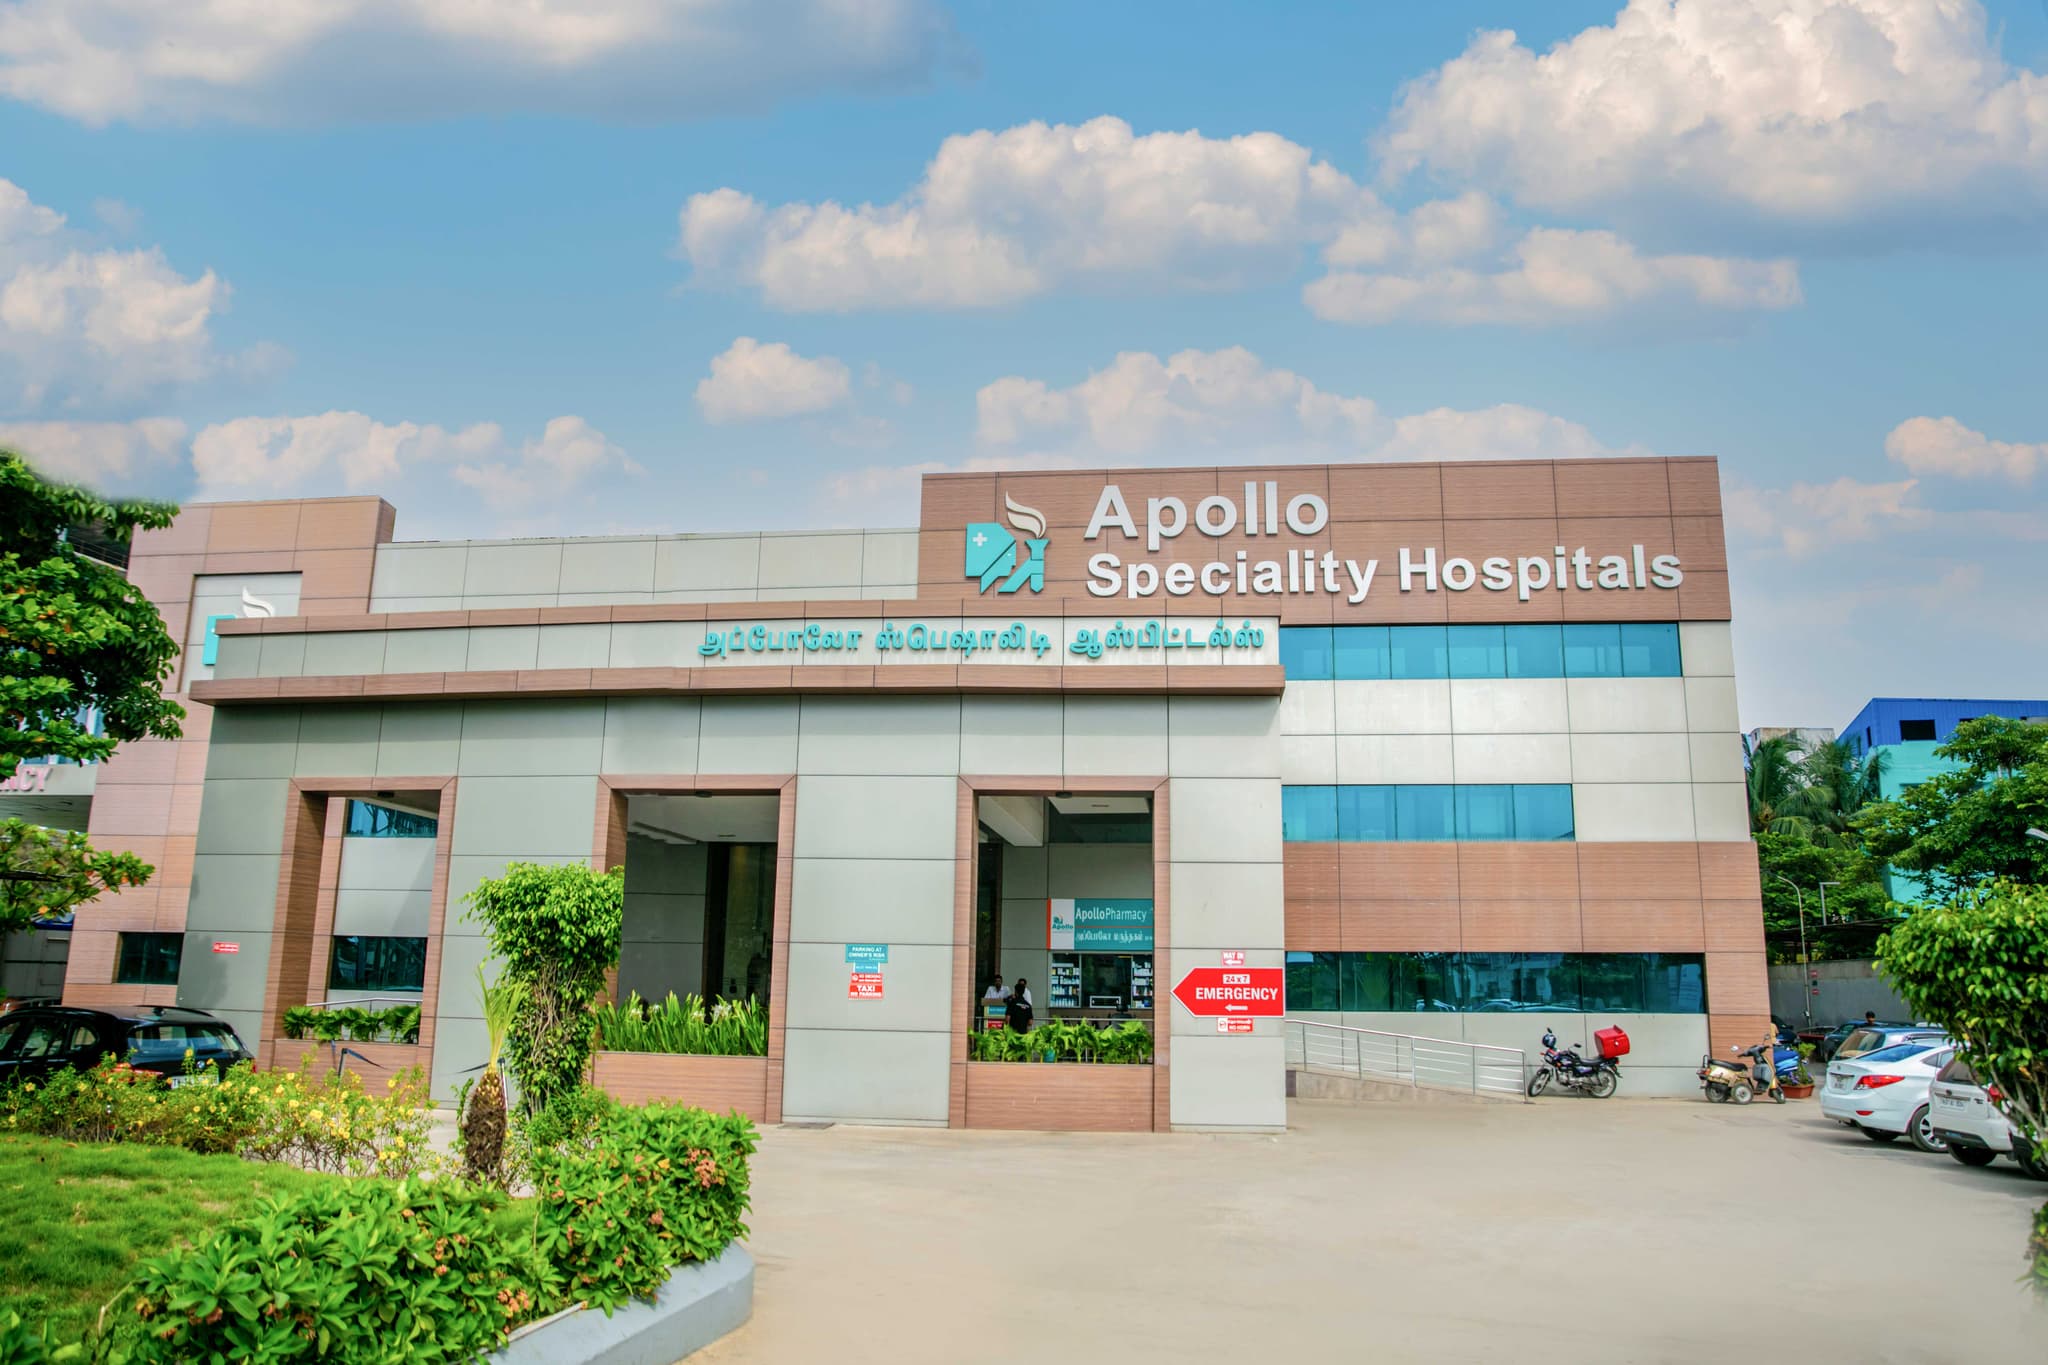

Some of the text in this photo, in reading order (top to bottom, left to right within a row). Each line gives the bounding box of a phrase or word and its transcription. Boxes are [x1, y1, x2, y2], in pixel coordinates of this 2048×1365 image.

[1083, 480, 1330, 552] Apollo
[1085, 544, 1684, 605] Speciality Hospitals
[697, 619, 1265, 660] அப்போலோ ஸ்பெஷாலிடி ஆஸ்பிட்டல்ஸ்
[1195, 987, 1279, 1001] EMERGENCY
